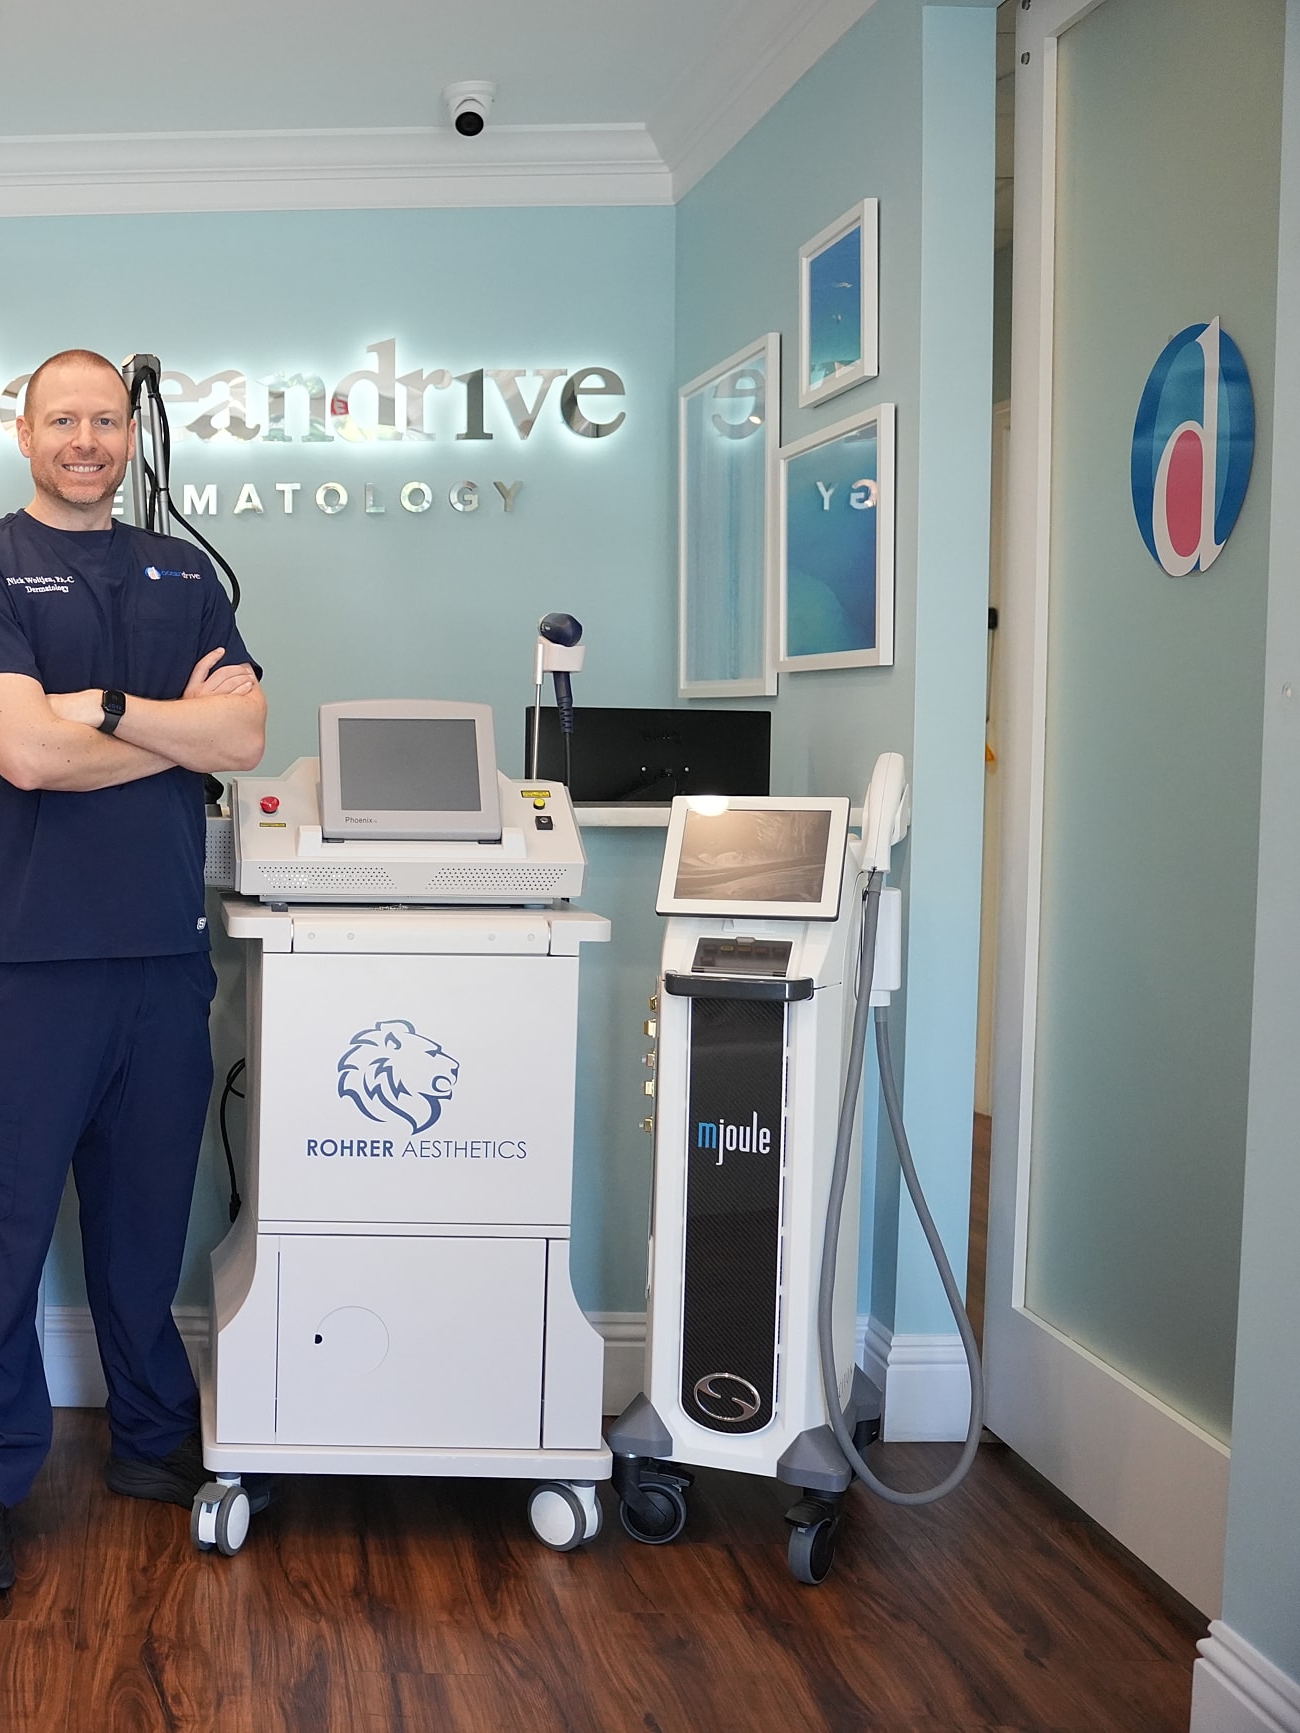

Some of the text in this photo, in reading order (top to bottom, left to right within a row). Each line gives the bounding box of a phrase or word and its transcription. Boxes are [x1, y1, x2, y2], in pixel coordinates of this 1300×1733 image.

[111, 480, 524, 514] MATOLOGY
[25, 583, 70, 593] Dermatology
[345, 816, 373, 824] Phoenix
[306, 1138, 528, 1159] ROHRER AESTHETICS
[697, 1110, 771, 1166] mjoule
